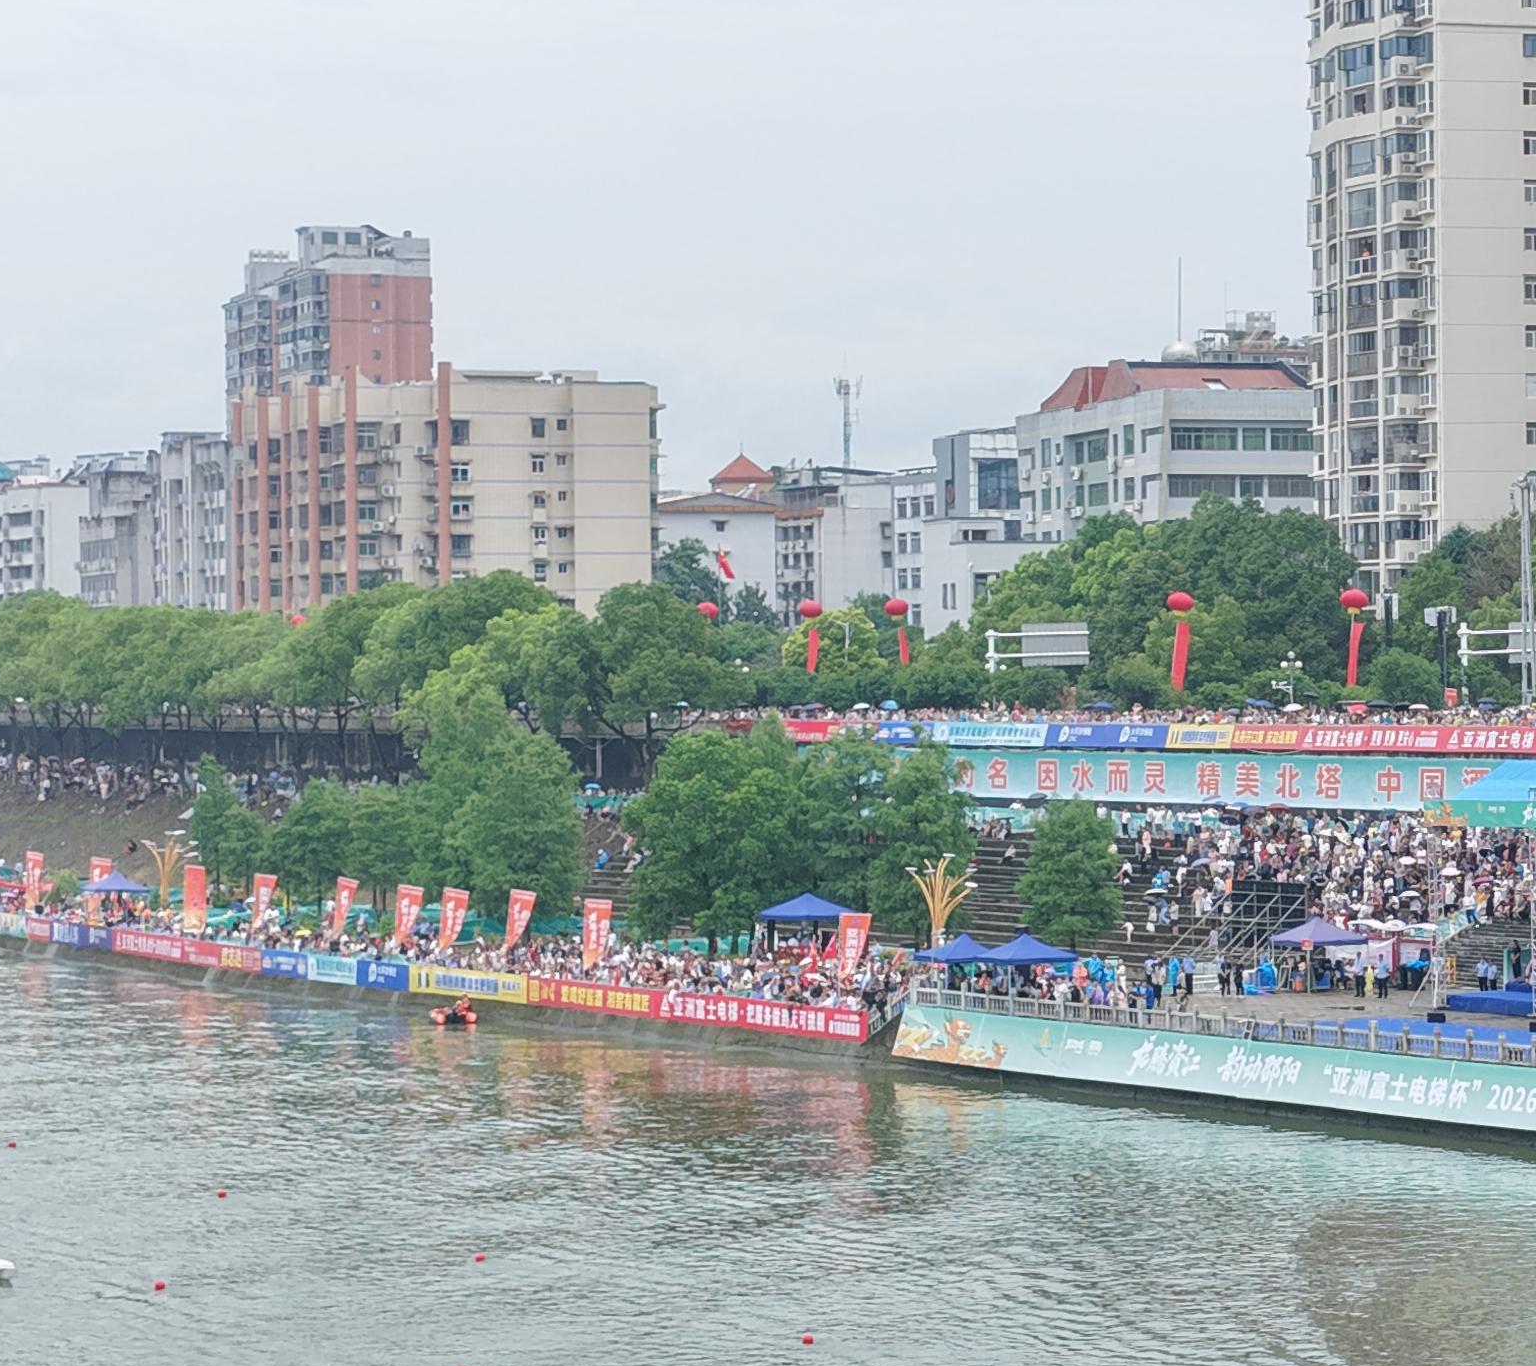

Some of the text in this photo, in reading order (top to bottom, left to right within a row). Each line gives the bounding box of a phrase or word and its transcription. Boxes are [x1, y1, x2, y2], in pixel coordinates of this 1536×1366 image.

[1035, 758, 1167, 795] 因水而灵
[1197, 762, 1341, 800] 精美北塔
